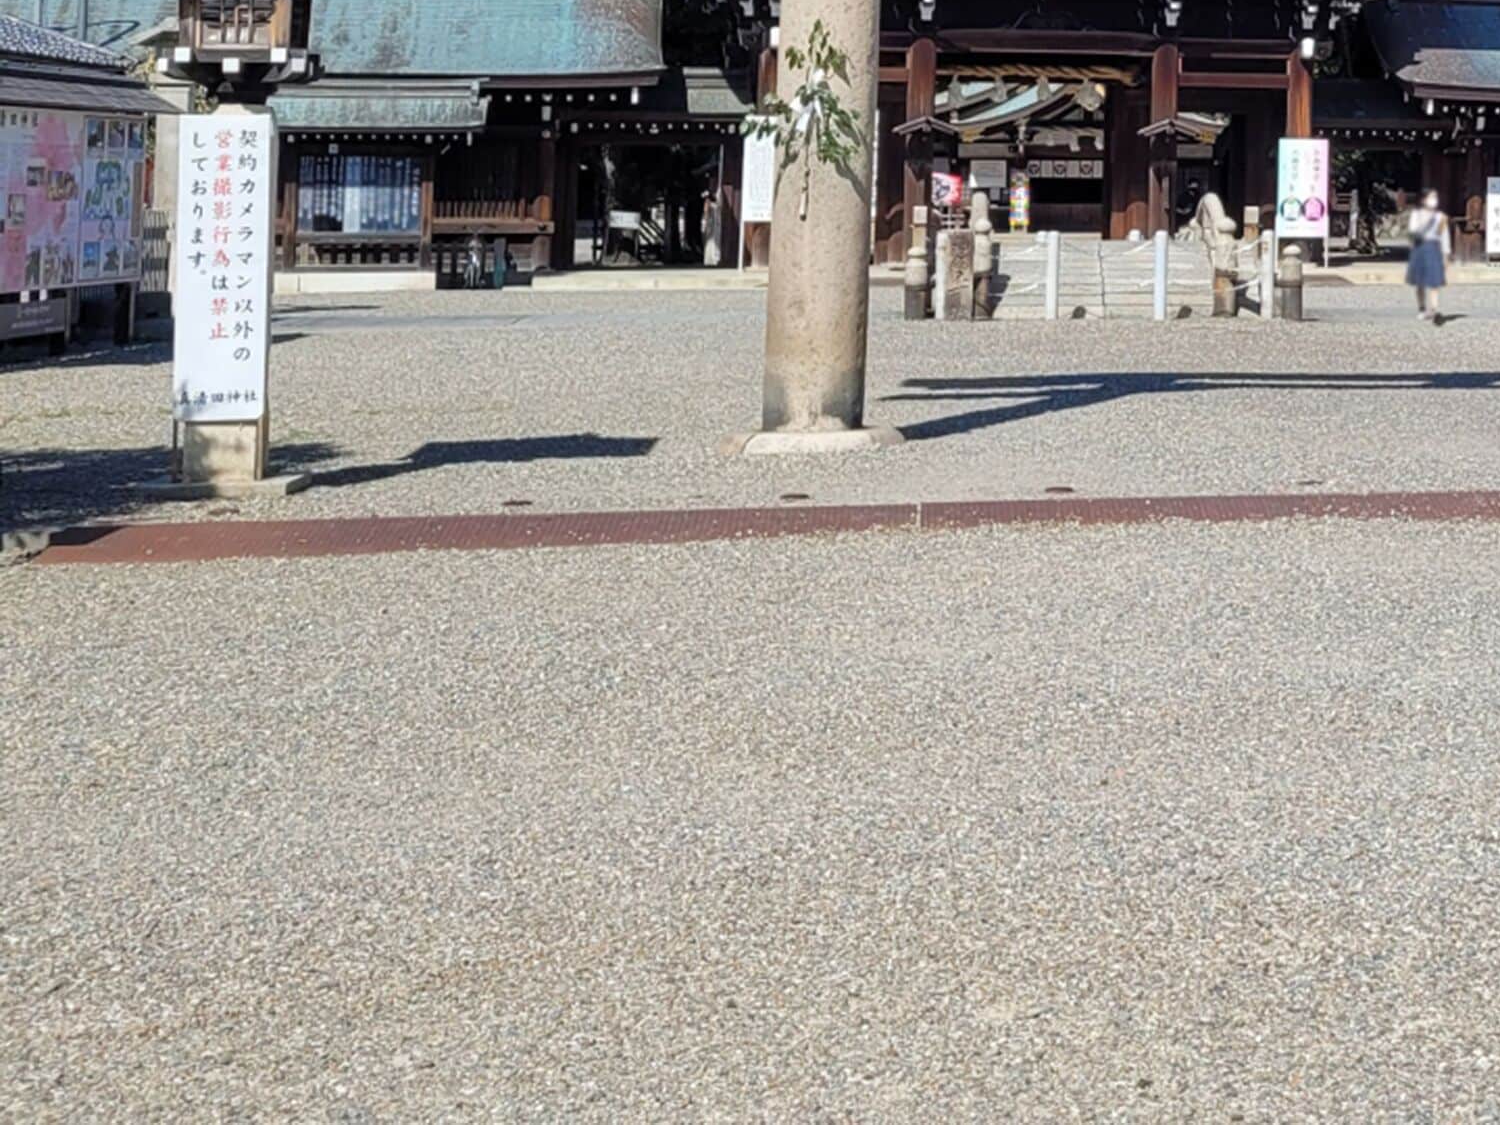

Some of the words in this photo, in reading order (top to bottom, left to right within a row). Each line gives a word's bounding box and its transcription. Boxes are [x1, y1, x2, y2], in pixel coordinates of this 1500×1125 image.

[187, 131, 209, 275] しております。
[209, 128, 234, 340] 営業撮影行為は禁止
[233, 130, 258, 361] 契約カメラマン以外の
